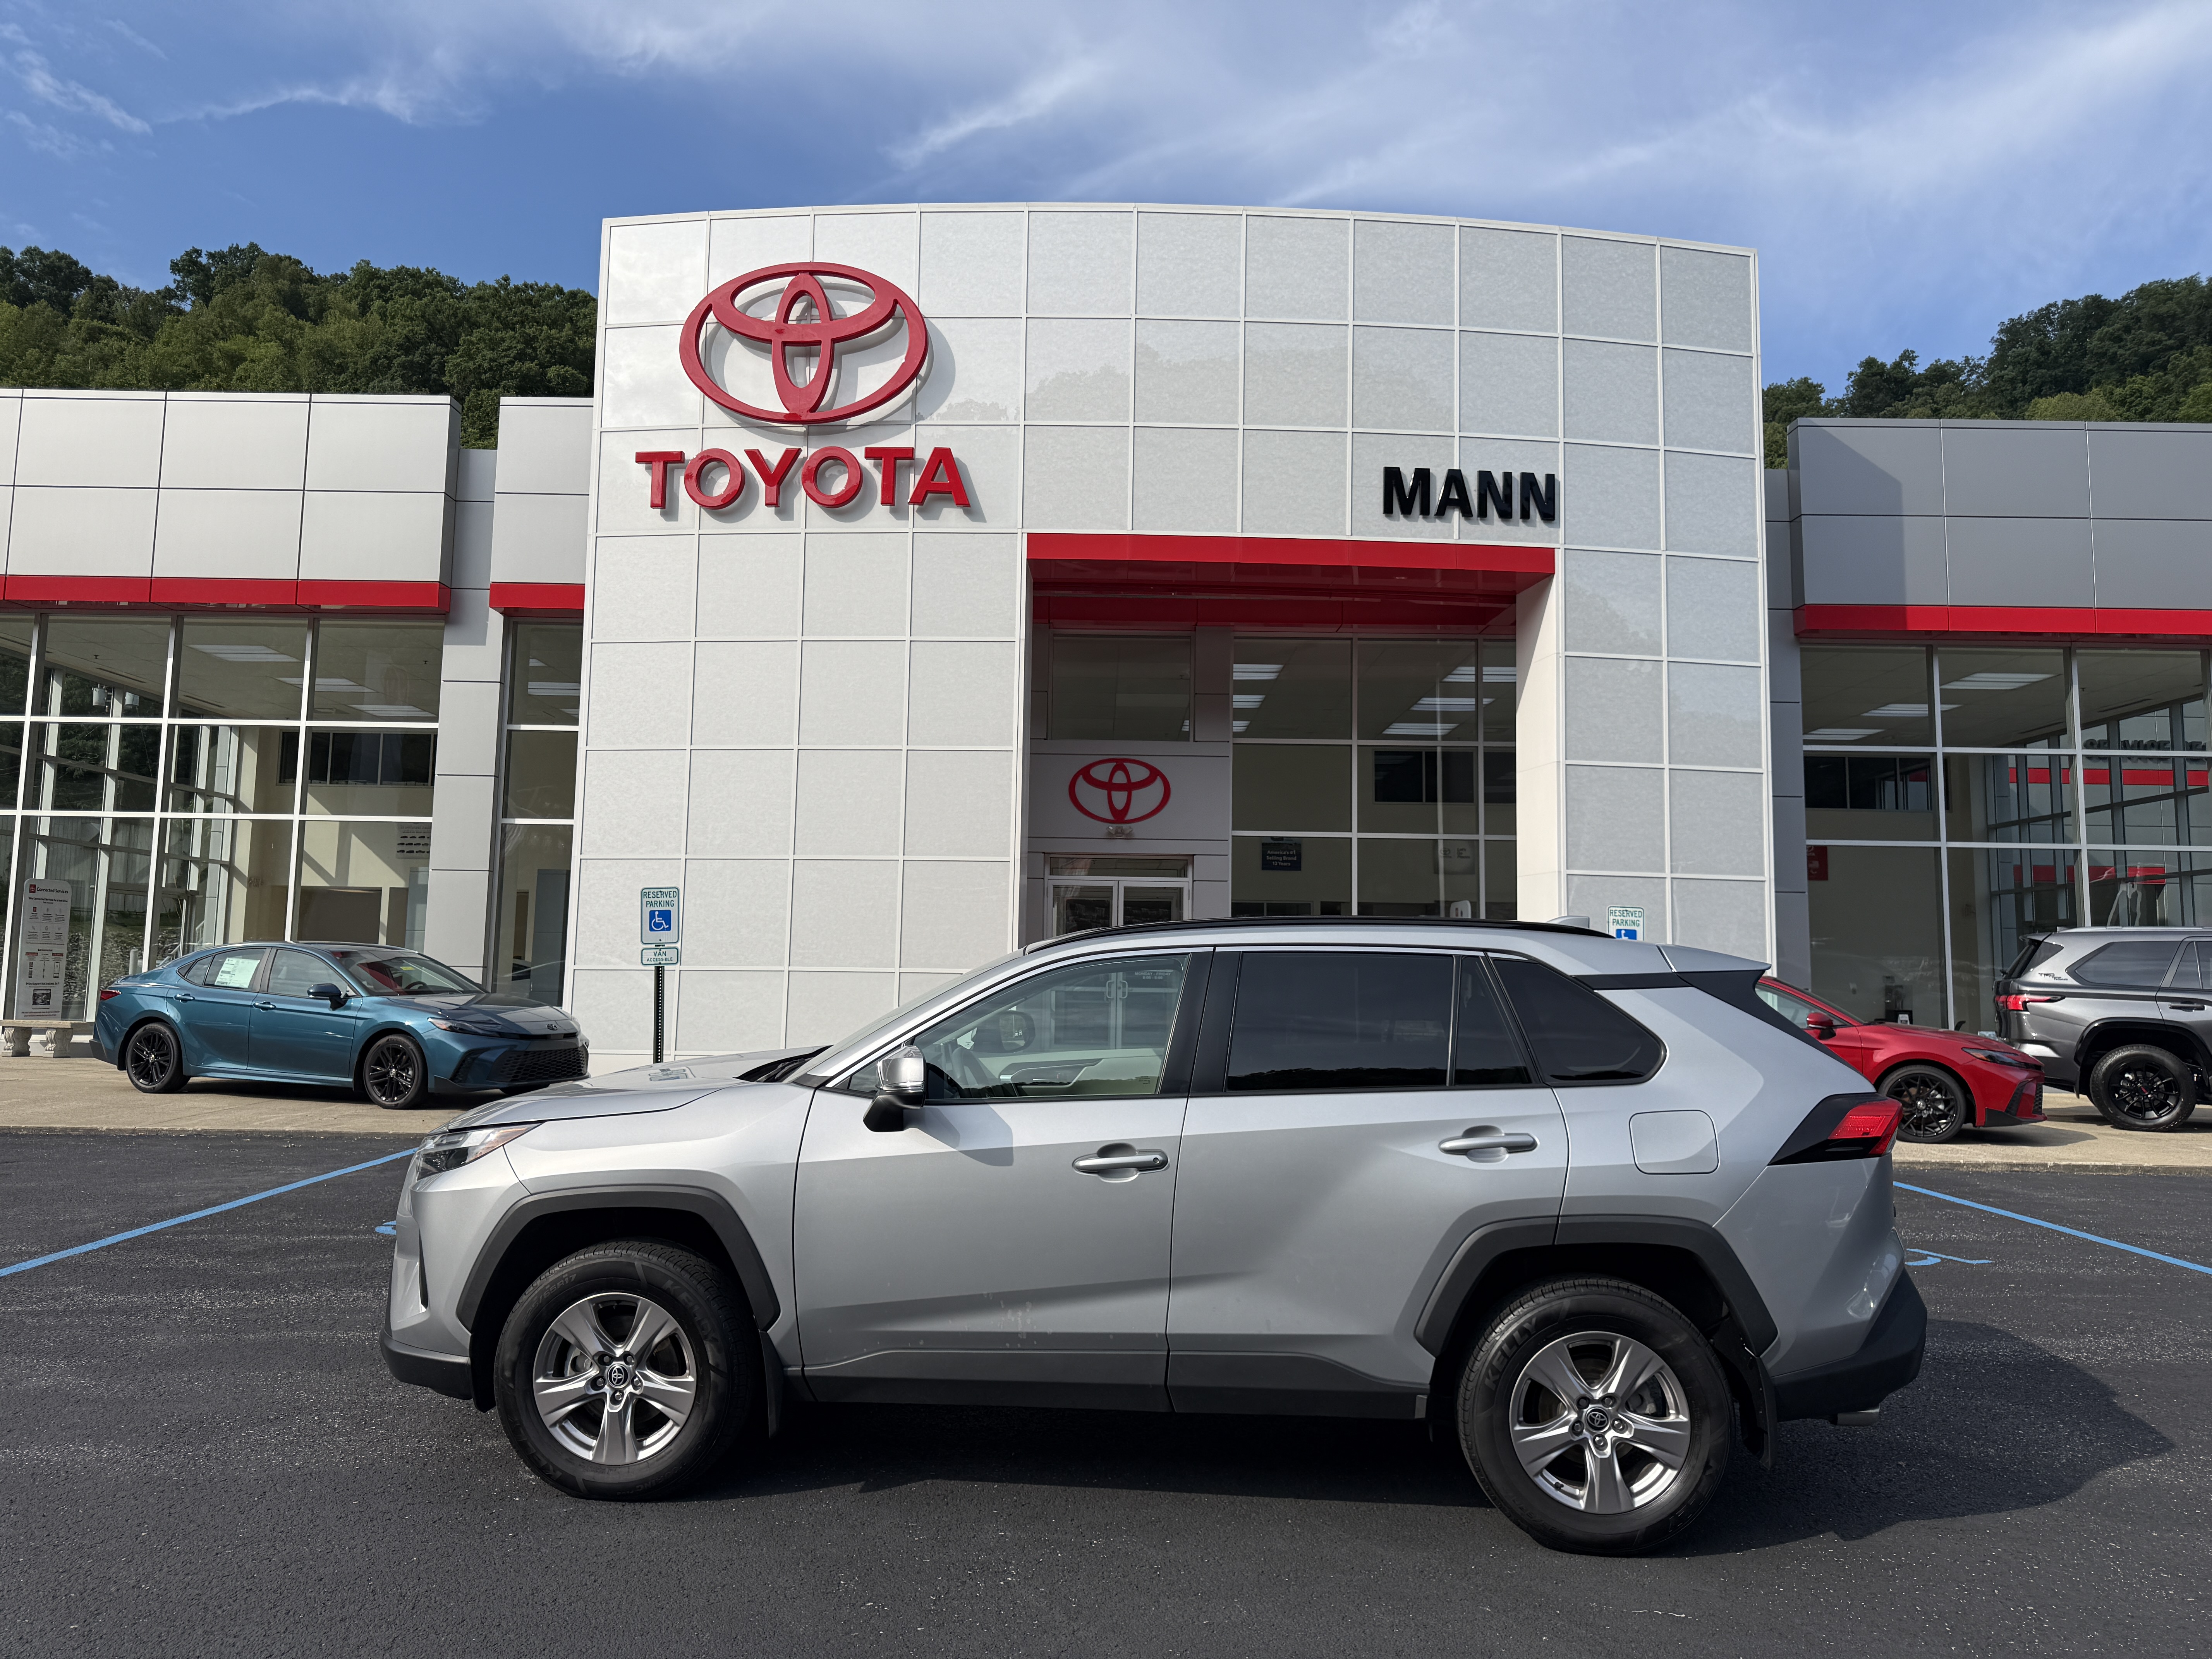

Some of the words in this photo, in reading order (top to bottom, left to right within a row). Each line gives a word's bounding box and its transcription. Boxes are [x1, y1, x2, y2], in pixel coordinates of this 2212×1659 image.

[635, 446, 971, 510] TOYOTA
[1382, 467, 1555, 521] MANN
[643, 891, 677, 899] RESERVED
[1609, 909, 1642, 918] RESERVED
[1612, 919, 1640, 927] PARKING
[662, 1279, 718, 1344] KELLY
[1482, 1317, 1541, 1392] KELLY
